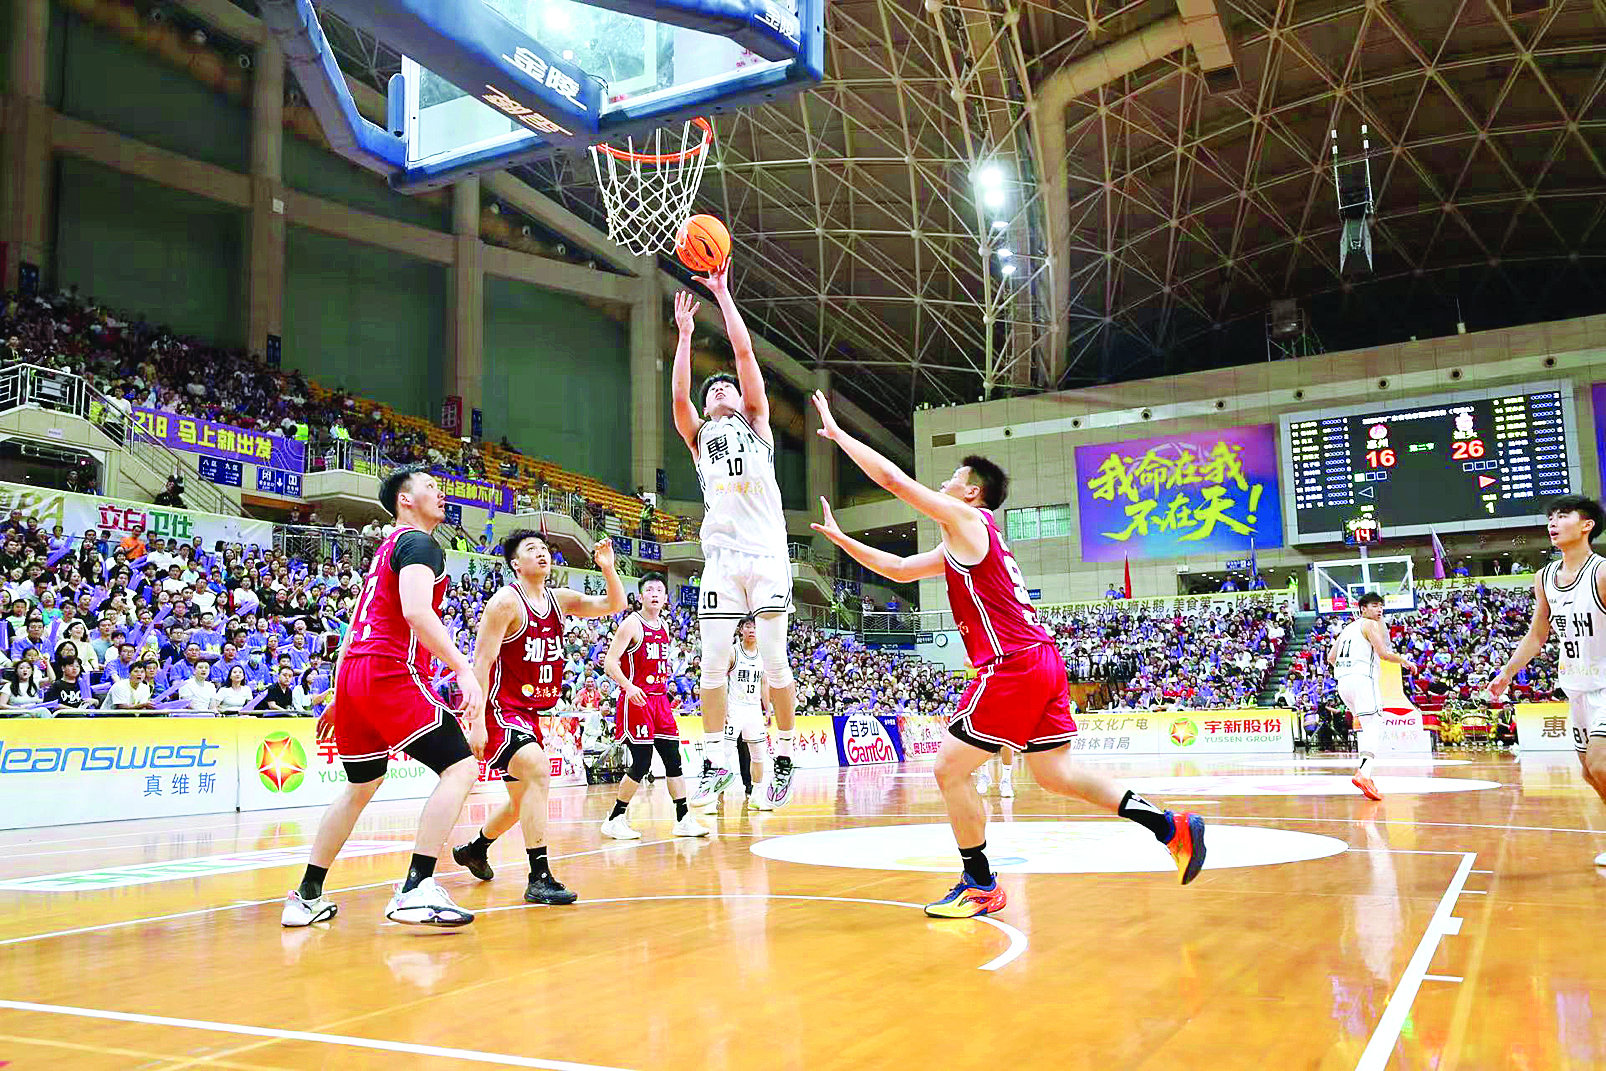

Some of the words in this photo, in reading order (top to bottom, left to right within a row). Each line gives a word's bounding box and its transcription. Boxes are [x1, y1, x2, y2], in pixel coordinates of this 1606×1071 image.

[506, 46, 586, 108] 金陵
[178, 420, 272, 459] 马上就出发
[1366, 449, 1396, 468] 16
[1452, 440, 1485, 460] 26
[726, 458, 743, 476] 10
[1087, 441, 1249, 503] 我命在我
[97, 504, 193, 540] 立白卫仕
[702, 591, 718, 609] 10
[523, 635, 565, 663] 汕头
[1339, 639, 1352, 658] 11
[1564, 641, 1580, 659] 81
[538, 664, 553, 684] 10
[746, 684, 755, 694] 13
[635, 724, 649, 738] 14
[724, 725, 734, 736] 13
[849, 720, 880, 738] 百岁山
[1078, 718, 1149, 731] 市文化广电
[1204, 718, 1282, 734] 宇新股份
[1383, 718, 1416, 726] -NING
[1541, 715, 1567, 738] 惠
[1073, 736, 1131, 750] 游体育局
[1572, 727, 1590, 745] 81
[144, 772, 217, 797] 真维斯
[318, 770, 346, 783] YUS
